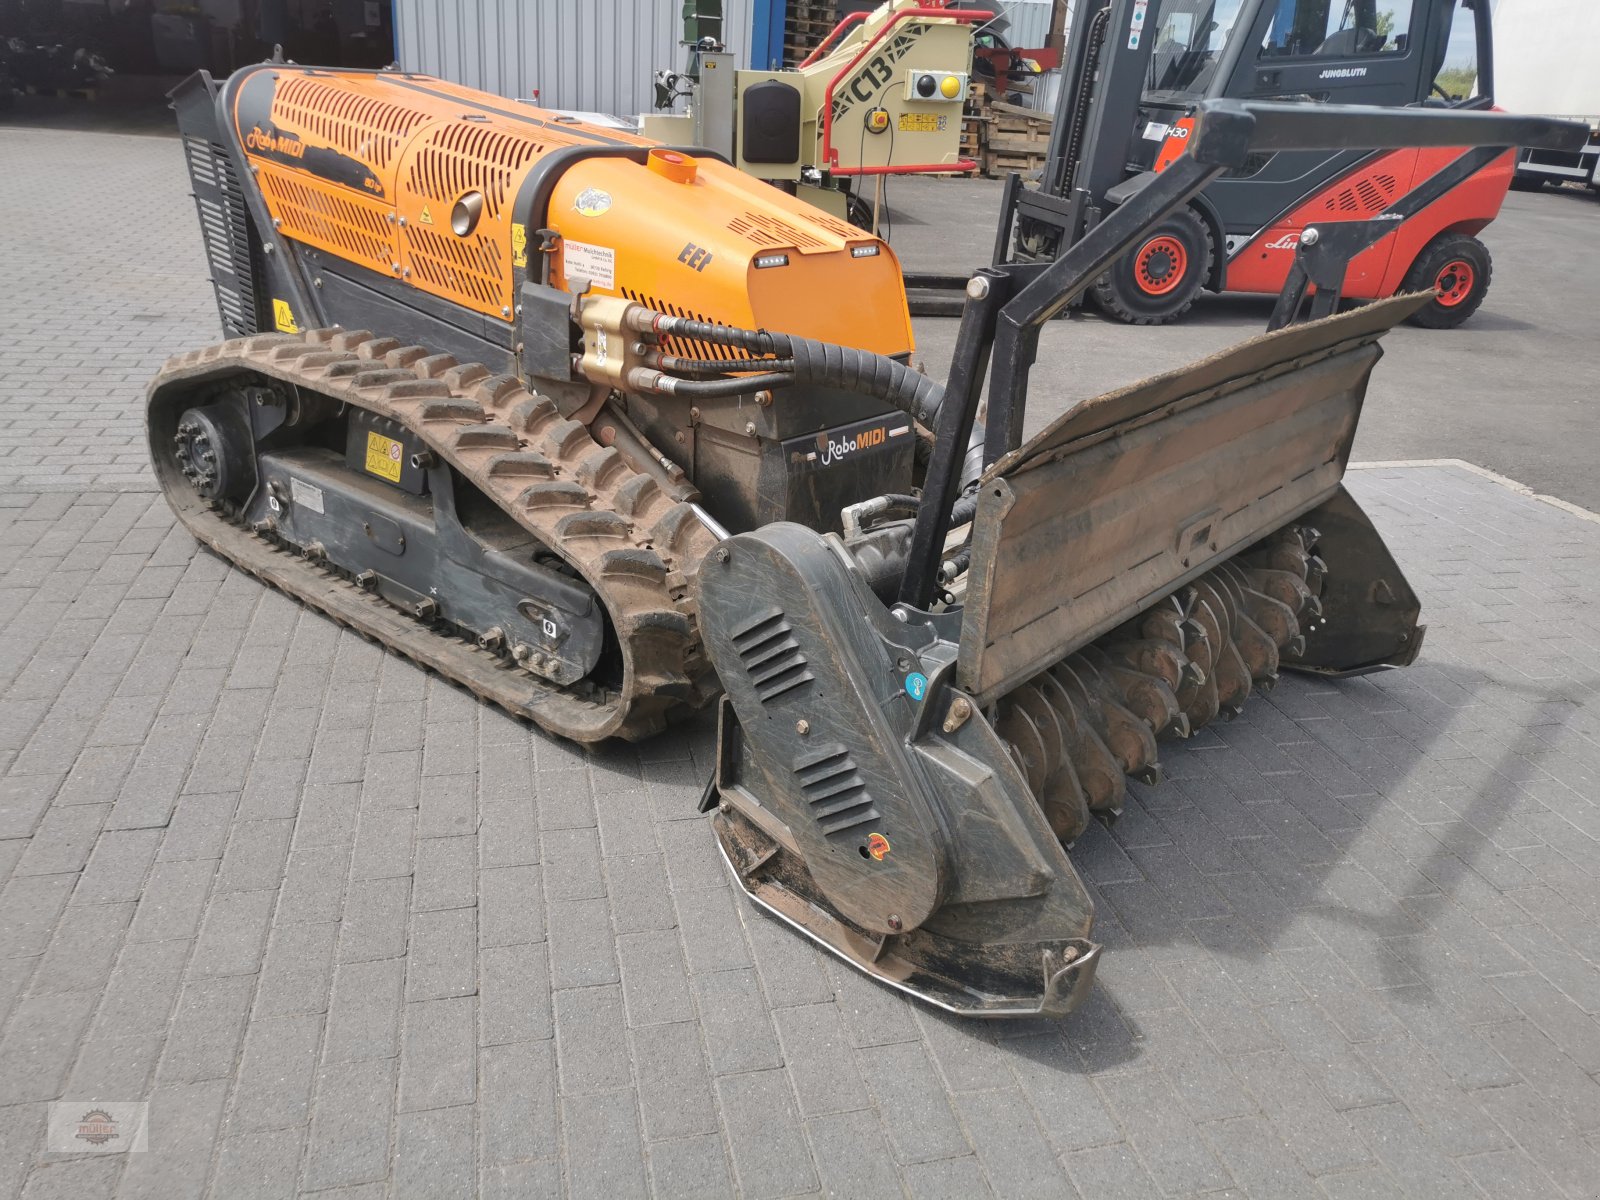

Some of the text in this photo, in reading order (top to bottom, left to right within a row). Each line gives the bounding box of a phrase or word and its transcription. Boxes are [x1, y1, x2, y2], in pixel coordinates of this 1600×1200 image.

[851, 56, 893, 102] C13
[1319, 67, 1367, 79] JUNGBLUTH
[1165, 126, 1188, 138] H30
[821, 426, 886, 466] RoboMIDI
